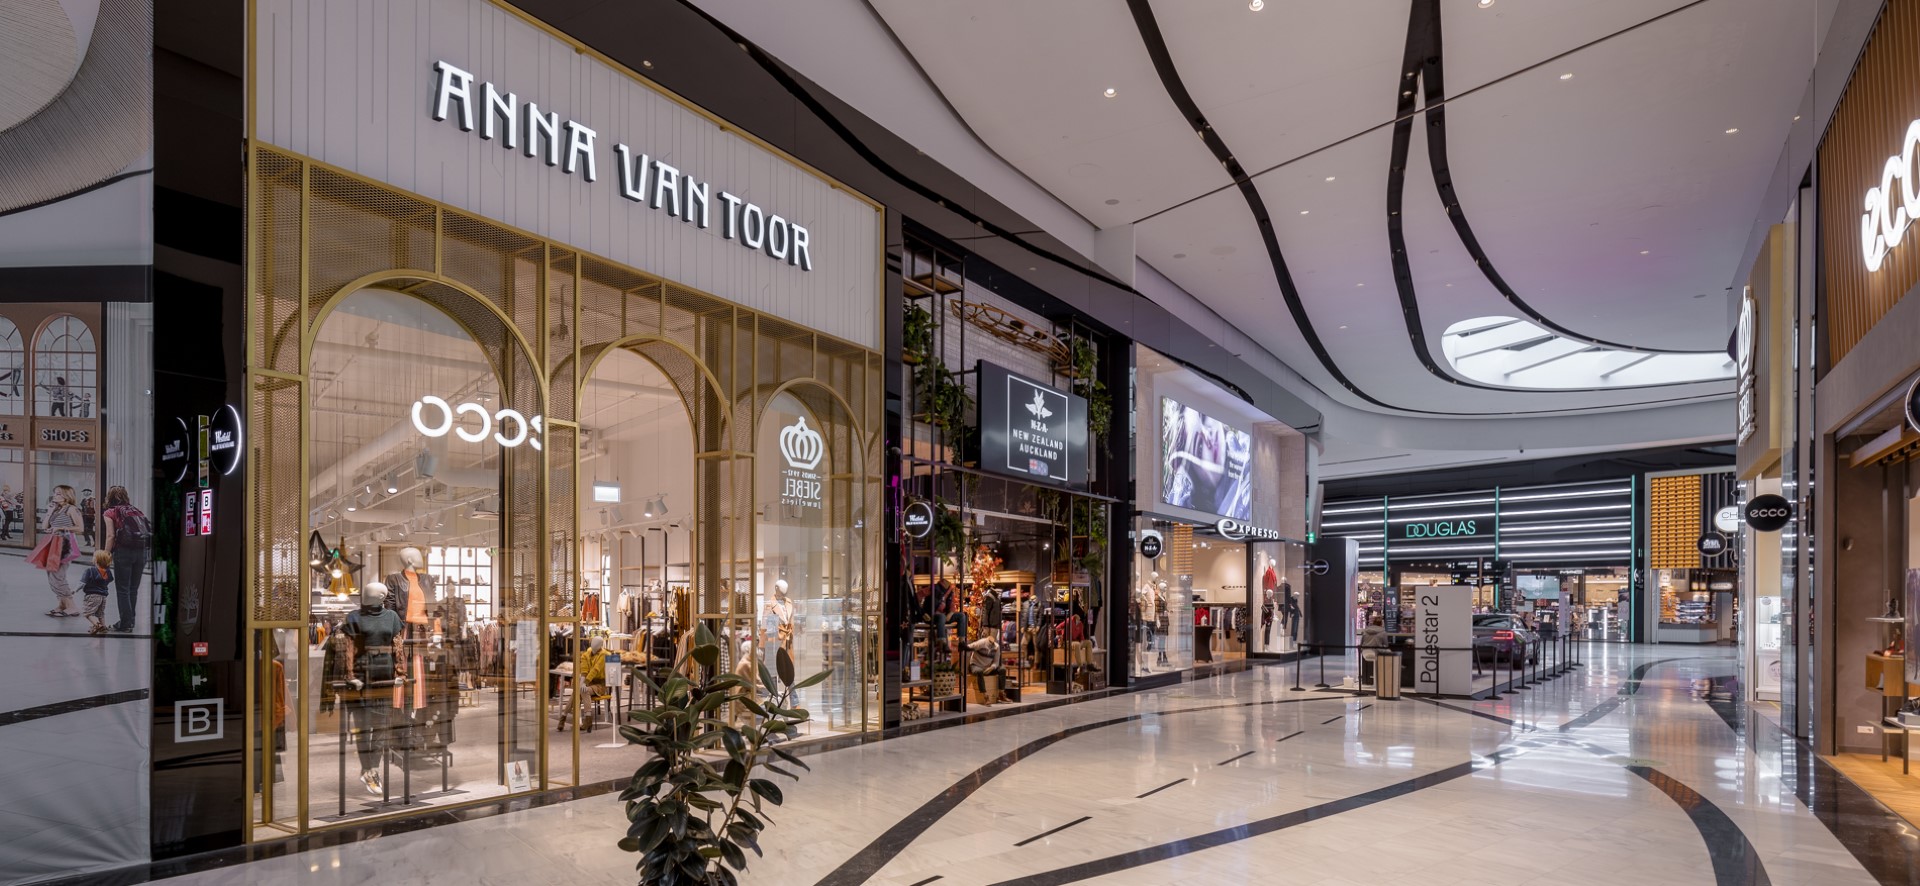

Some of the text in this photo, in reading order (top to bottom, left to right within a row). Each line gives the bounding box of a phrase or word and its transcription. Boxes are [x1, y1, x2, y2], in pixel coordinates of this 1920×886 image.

[432, 60, 812, 271] ANNA VAN TOOR
[41, 428, 89, 443] SHOES
[1012, 428, 1064, 450] NEW ZEALAND
[1019, 443, 1058, 461] AUCKLAND
[1749, 508, 1788, 518] ecco
[1406, 520, 1476, 538] DOUGLAS
[1420, 594, 1439, 684] Polestar 2
[188, 707, 211, 734] B
